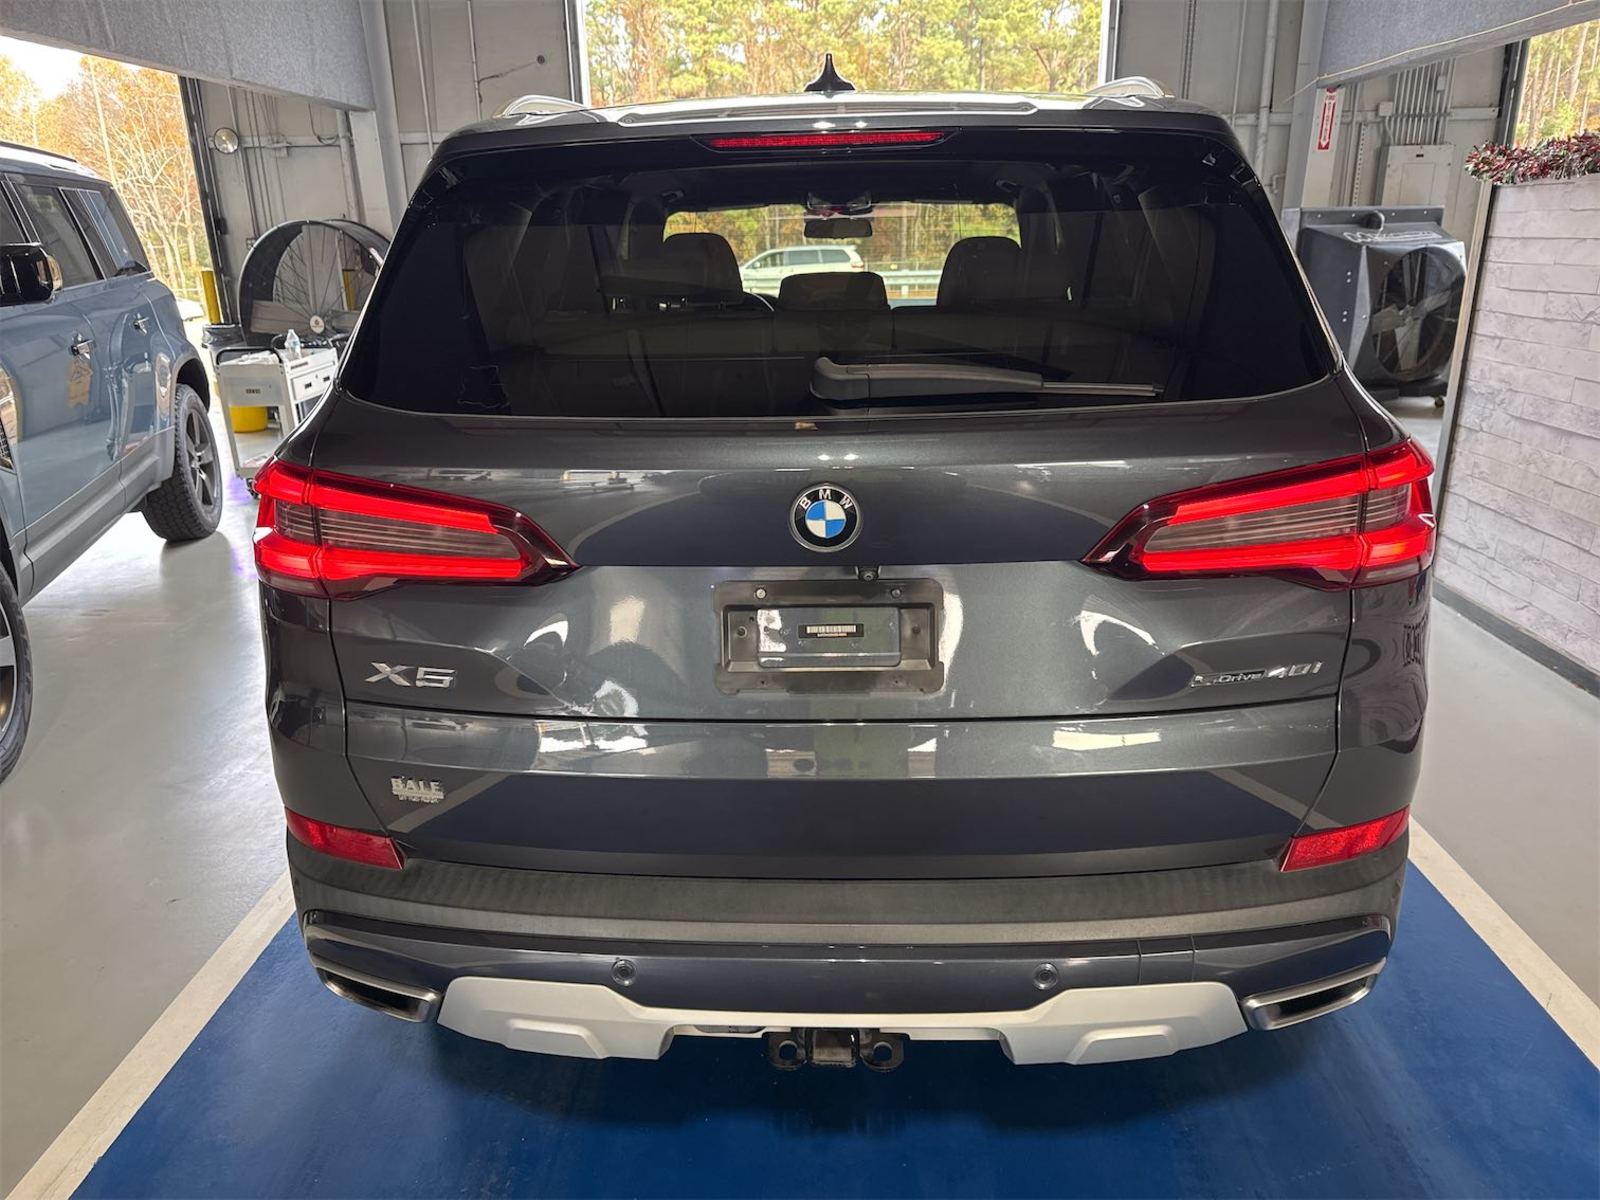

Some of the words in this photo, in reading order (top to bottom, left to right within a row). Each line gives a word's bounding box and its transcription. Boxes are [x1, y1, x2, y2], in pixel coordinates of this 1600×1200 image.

[799, 489, 853, 510] BMW
[364, 661, 455, 688] X5
[391, 777, 443, 796] BALE
